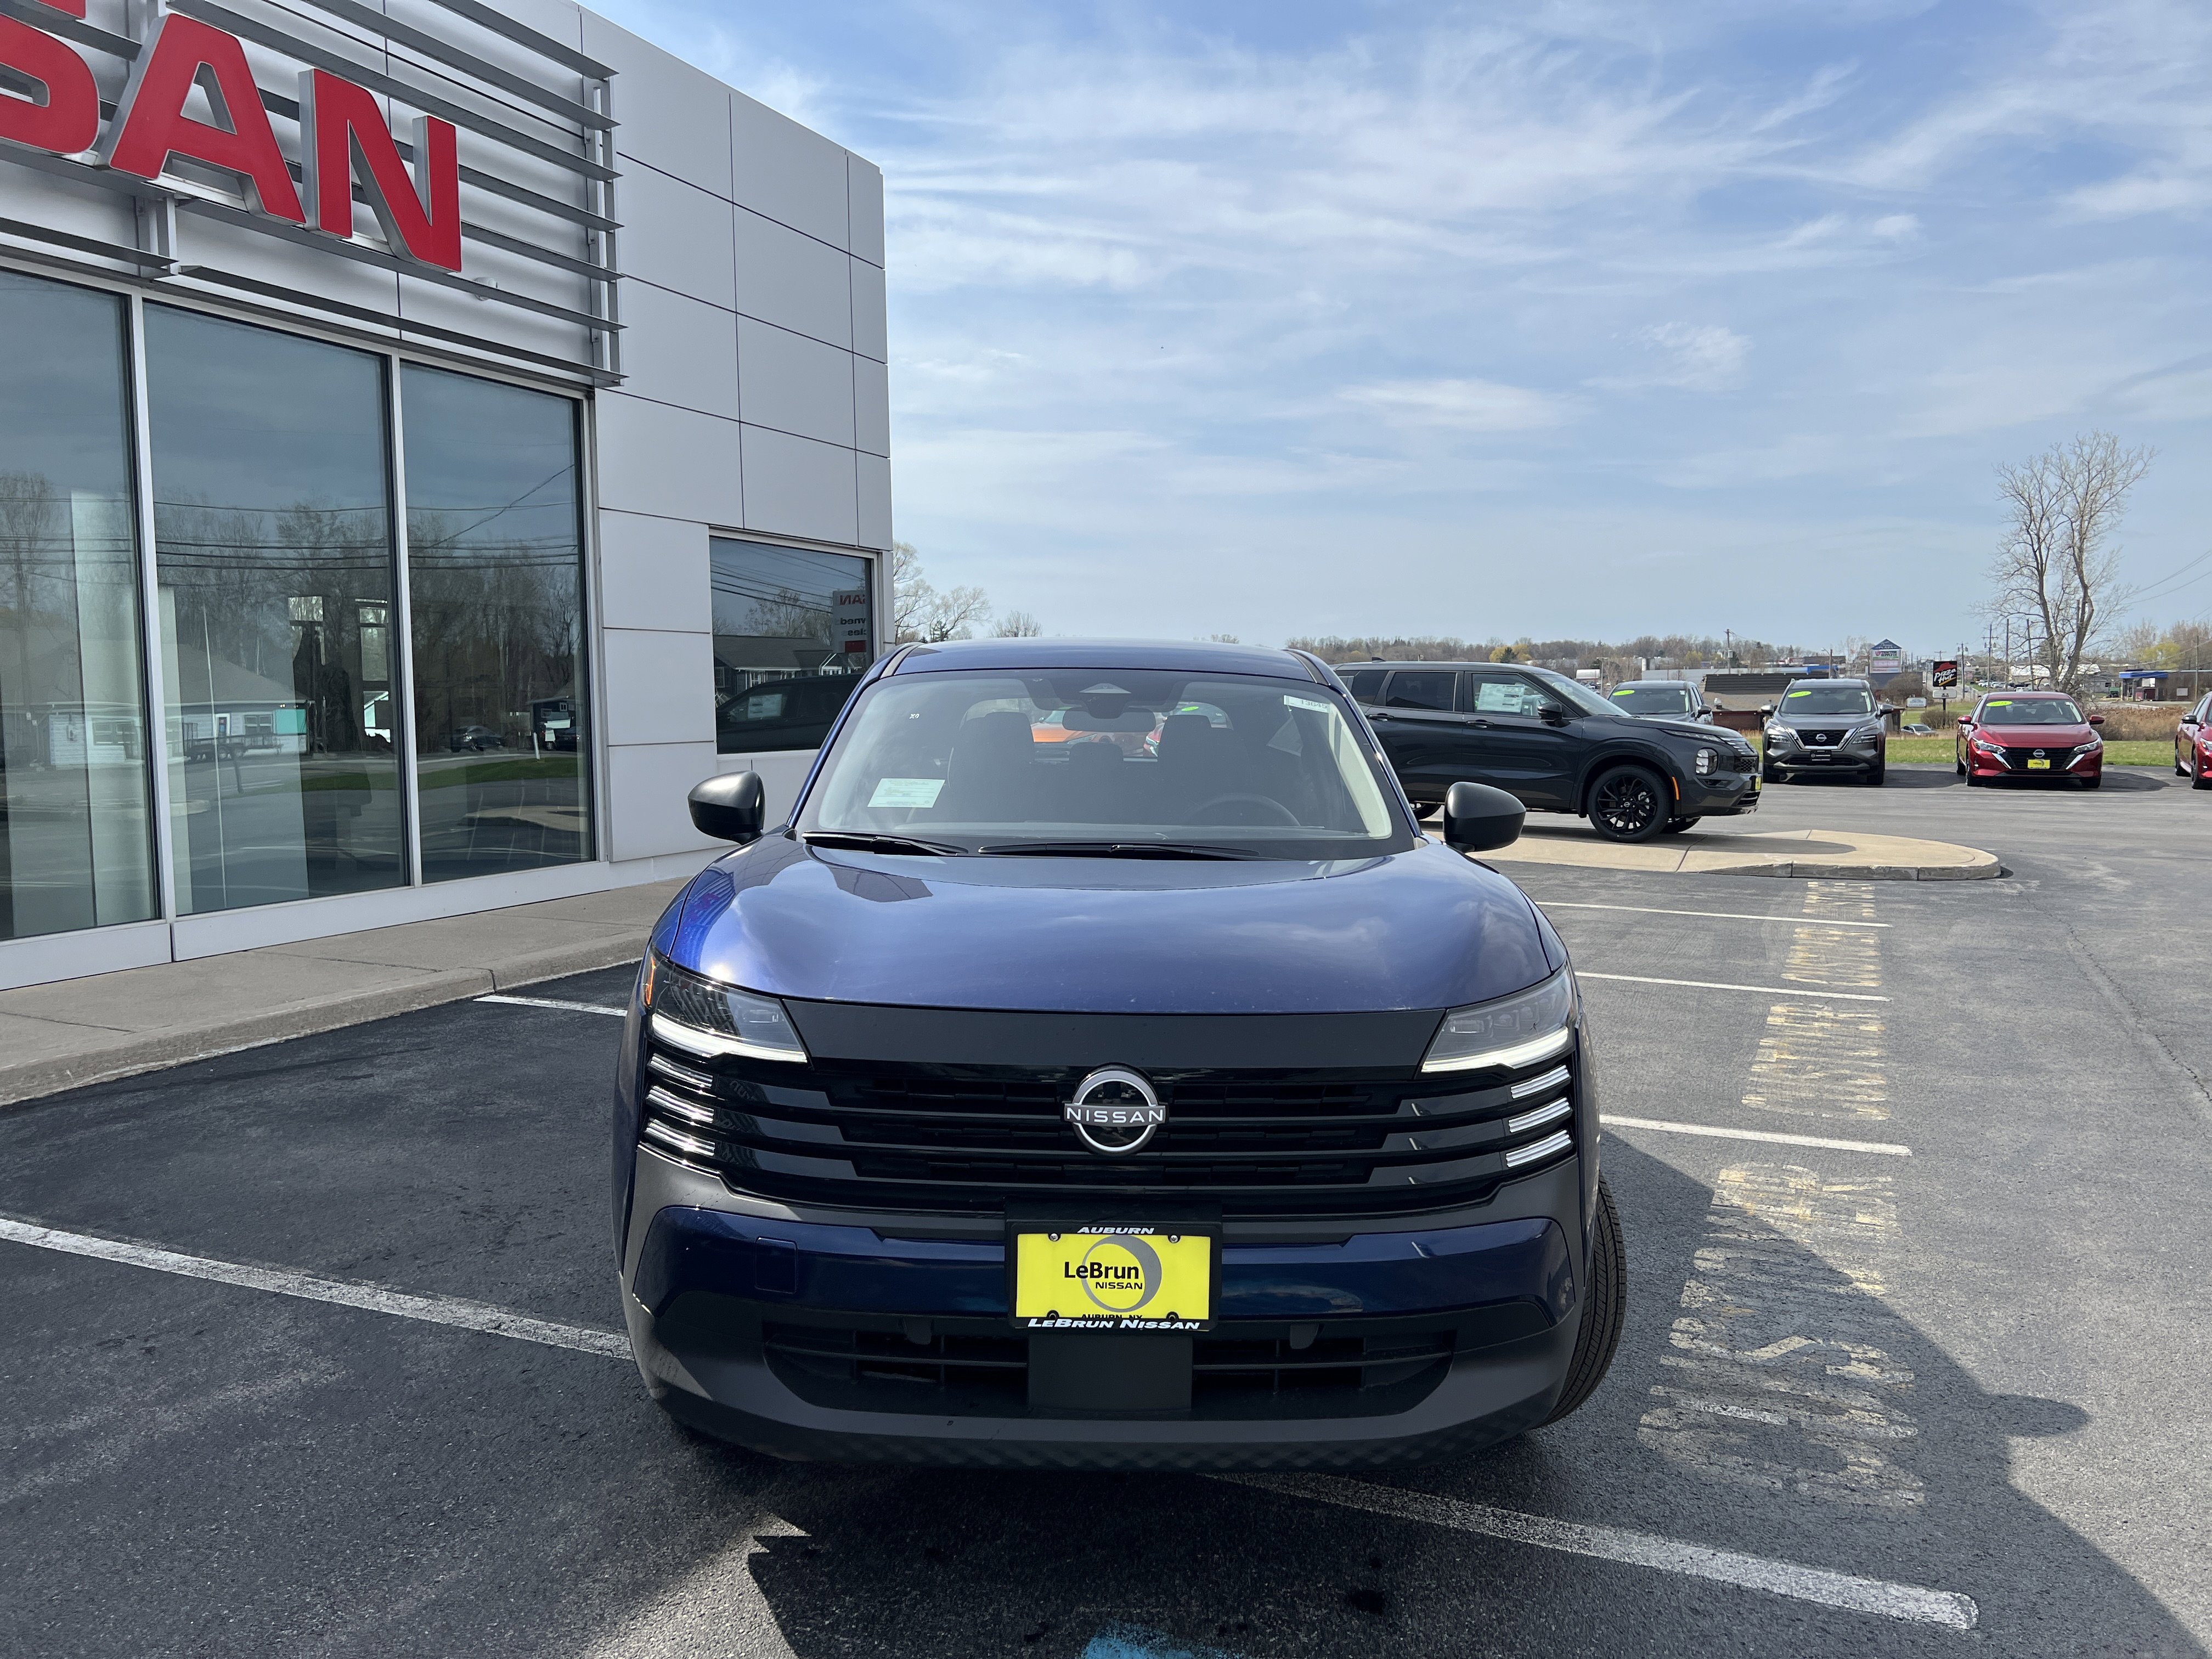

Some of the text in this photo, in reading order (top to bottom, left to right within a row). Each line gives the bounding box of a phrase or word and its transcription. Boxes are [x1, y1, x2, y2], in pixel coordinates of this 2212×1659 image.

[1934, 668, 1957, 682] Pizza
[1938, 673, 1955, 684] Hut
[1066, 1107, 1164, 1123] NISSAN
[1064, 1261, 1139, 1279] LeBrun
[1096, 1282, 1143, 1290] NISSAN
